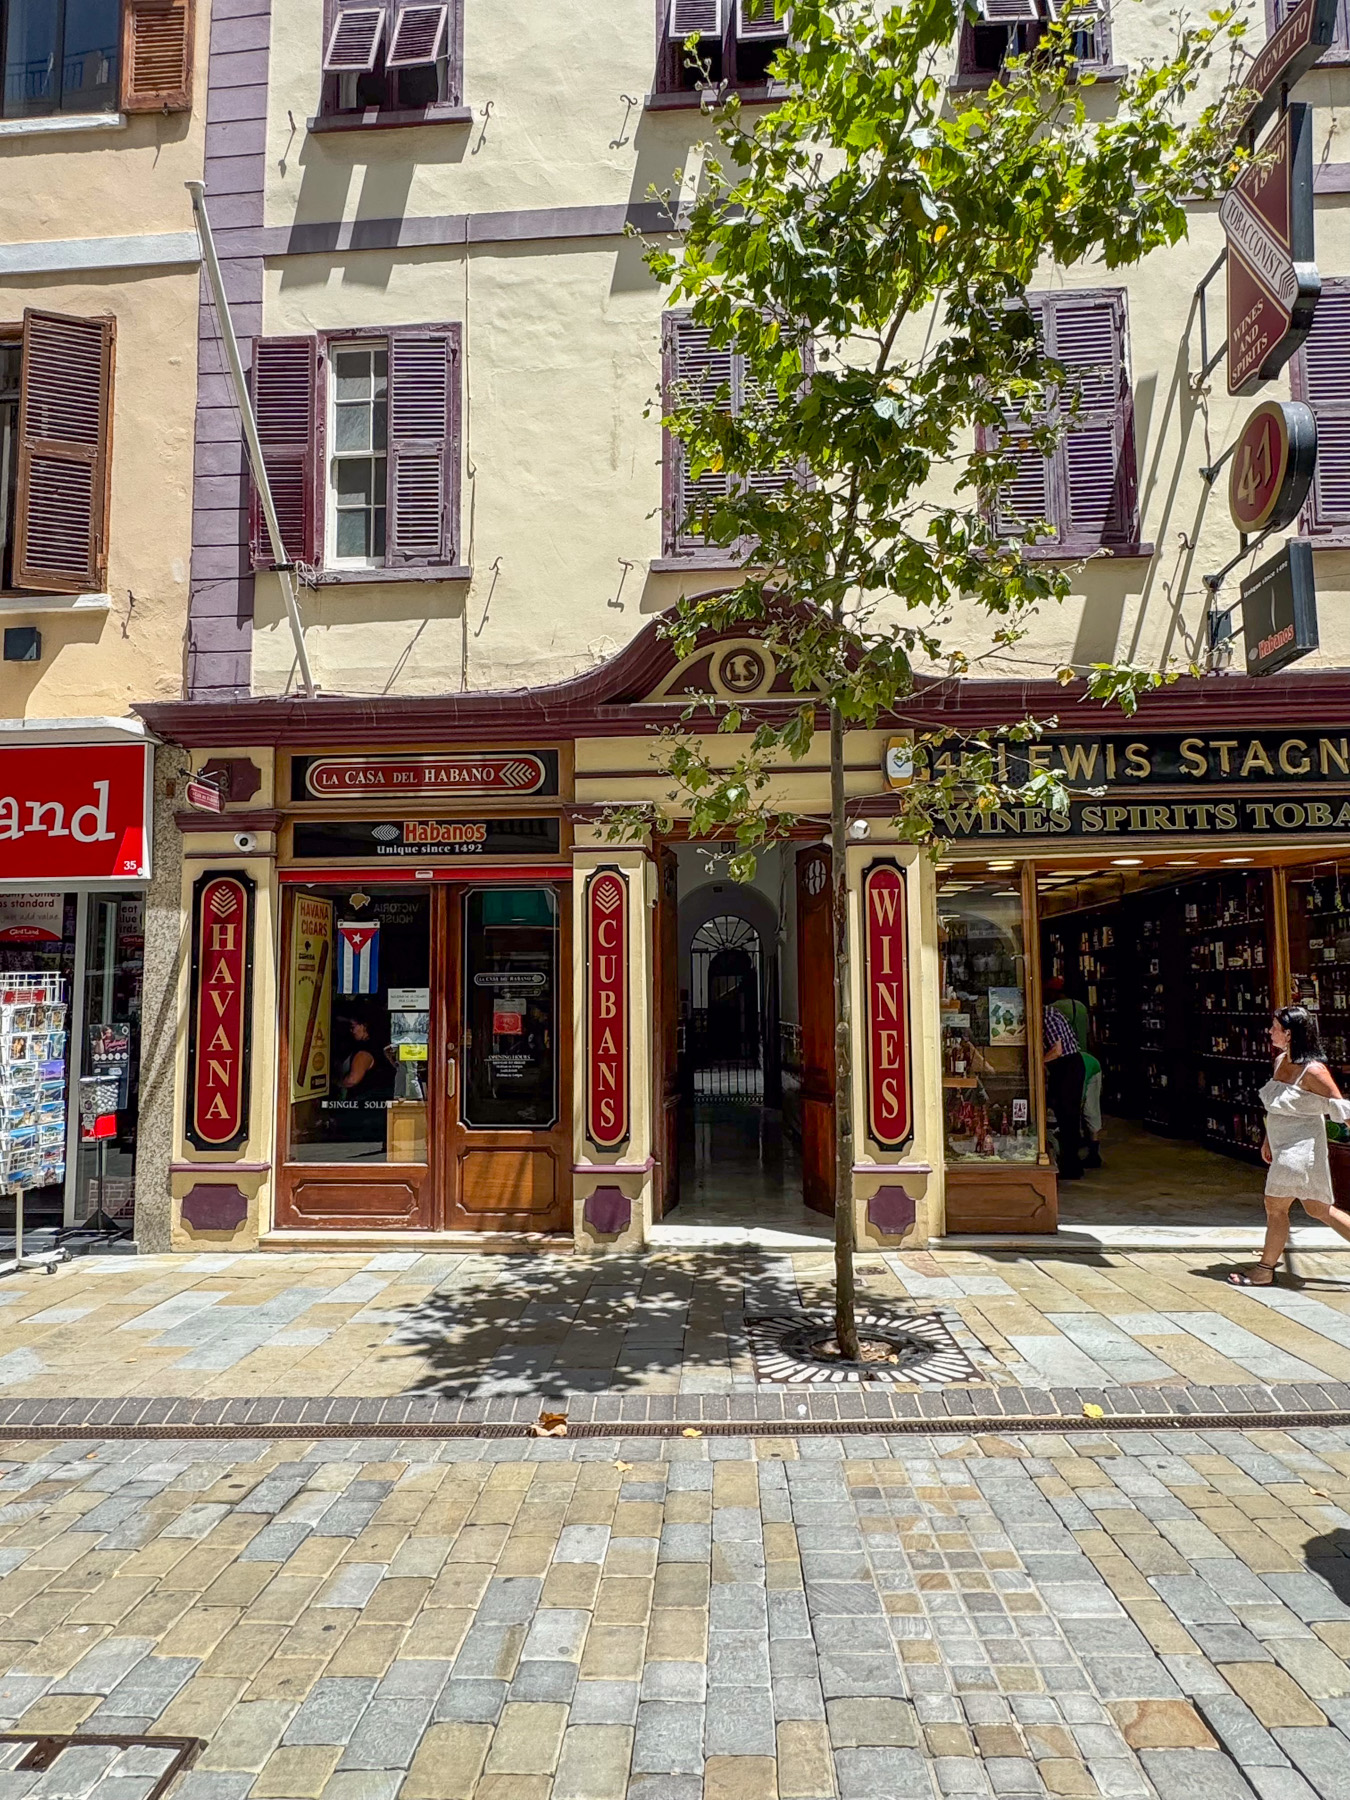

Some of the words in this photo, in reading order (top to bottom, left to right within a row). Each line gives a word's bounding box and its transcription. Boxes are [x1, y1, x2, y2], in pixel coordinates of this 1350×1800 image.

[1246, 11, 1308, 93] TAGNETTO
[1226, 199, 1283, 280] TOBACCONIST
[1233, 298, 1264, 342] WINES
[1238, 325, 1259, 356] AND
[1232, 333, 1268, 382] SPIRITS
[1237, 421, 1272, 505] 41
[1258, 624, 1294, 659] Habanos
[729, 660, 756, 681] LS
[1179, 738, 1349, 777] STAGN
[322, 774, 339, 784] LA
[345, 770, 385, 784] CASA
[393, 772, 418, 784] DEL
[424, 768, 495, 783] HABANO
[403, 821, 487, 843] Habanos
[942, 808, 1071, 834] WINES
[1082, 804, 1238, 833] SPIRITS
[377, 845, 419, 855] Unique
[421, 844, 451, 853] since
[454, 843, 483, 852] 1492
[124, 860, 137, 870] 35
[11, 899, 54, 907] standard
[300, 901, 329, 920] HAVANA
[301, 919, 328, 937] CIGARS
[871, 889, 900, 1118] WINES
[204, 923, 237, 1119] HAVANA
[598, 919, 618, 1128] CUBANS
[329, 1101, 359, 1109] SINGLE
[364, 1101, 387, 1109] SOLD
